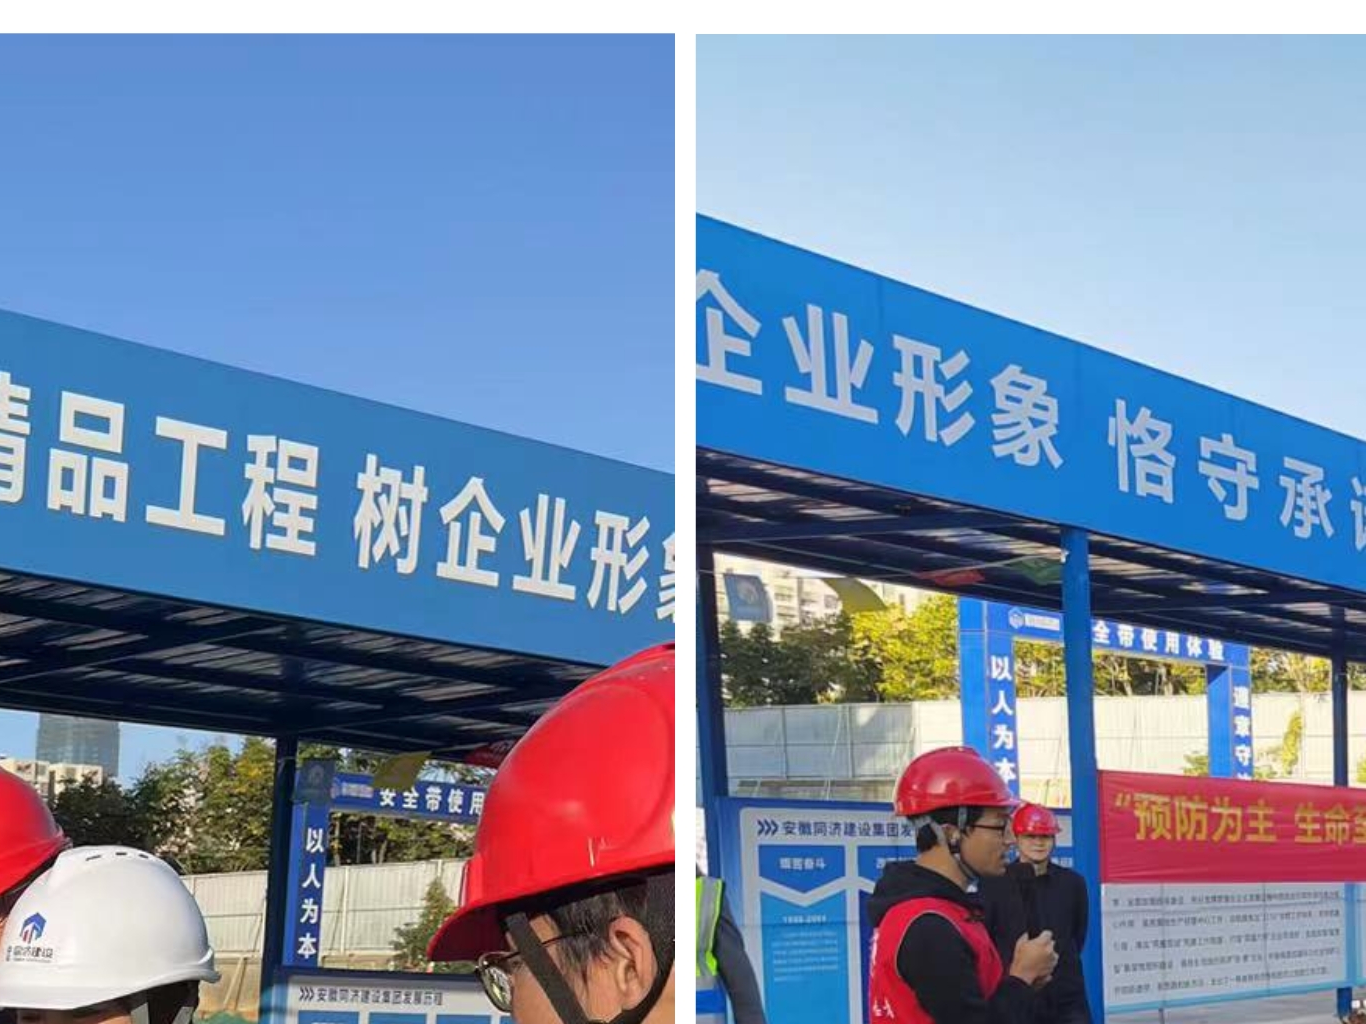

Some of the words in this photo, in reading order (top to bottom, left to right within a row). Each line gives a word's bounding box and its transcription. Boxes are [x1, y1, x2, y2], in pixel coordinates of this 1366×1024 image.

[696, 269, 1064, 470] 企业形象
[990, 655, 1017, 785] 以人为本
[297, 827, 325, 960] 以人为本
